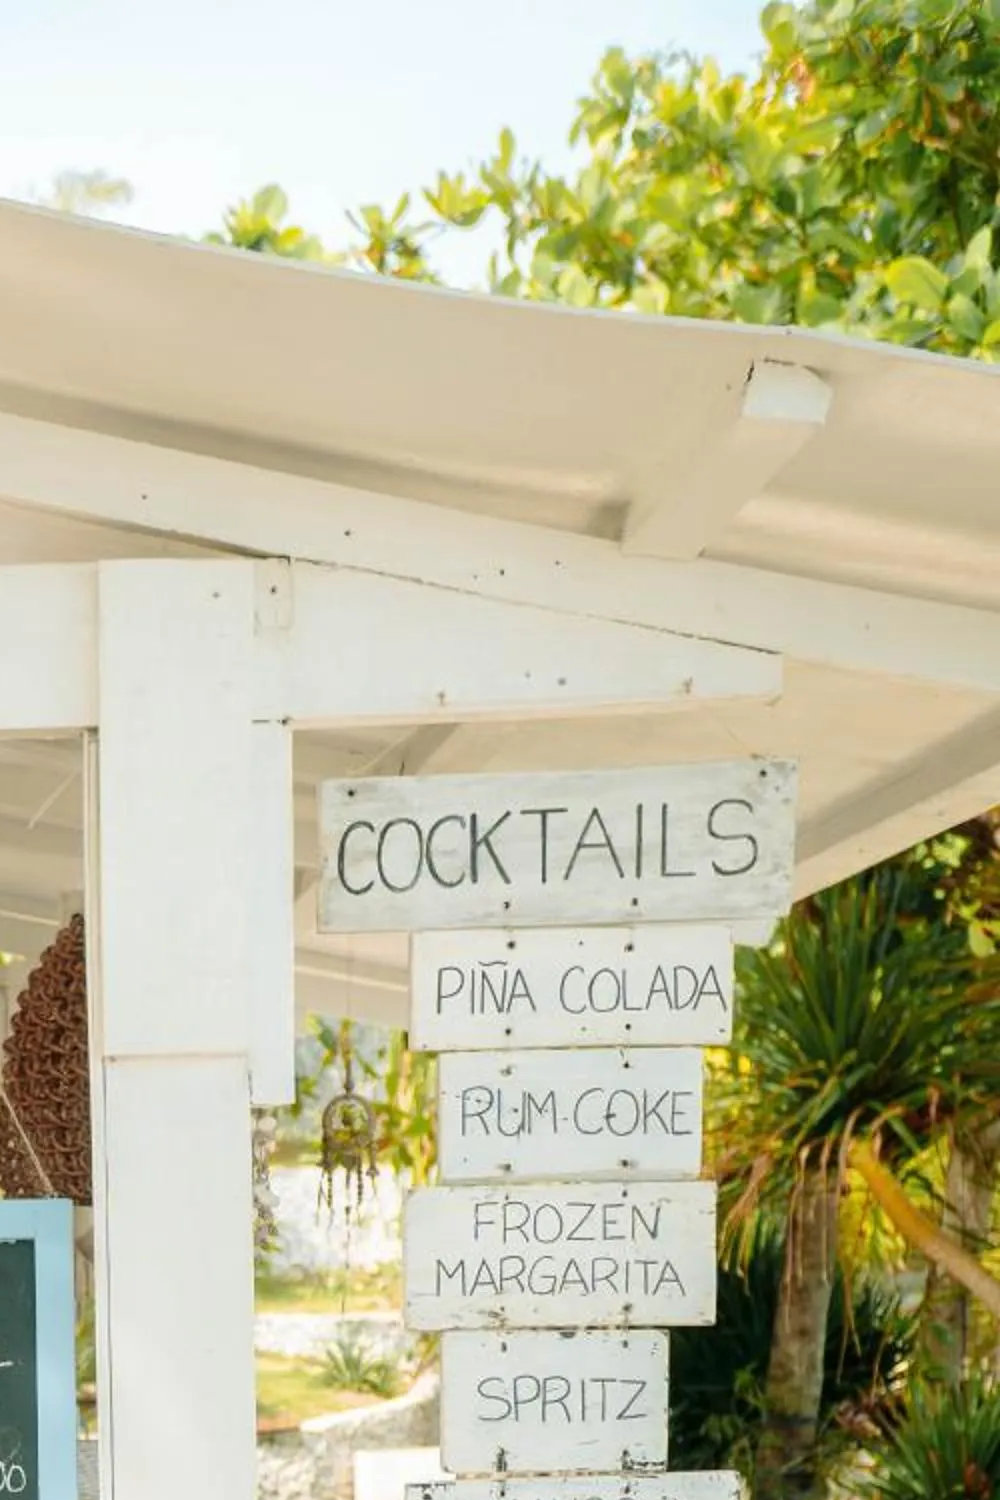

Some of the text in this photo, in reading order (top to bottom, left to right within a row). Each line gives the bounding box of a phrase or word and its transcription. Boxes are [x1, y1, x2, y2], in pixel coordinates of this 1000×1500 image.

[337, 799, 759, 896] COCKTAILS
[436, 961, 728, 1014] PIÑA COLADA
[461, 1086, 694, 1140] RUM COKE
[473, 1200, 662, 1244] FROZEN
[434, 1255, 686, 1297] MARGARITA
[476, 1375, 647, 1424] SPRITZ
